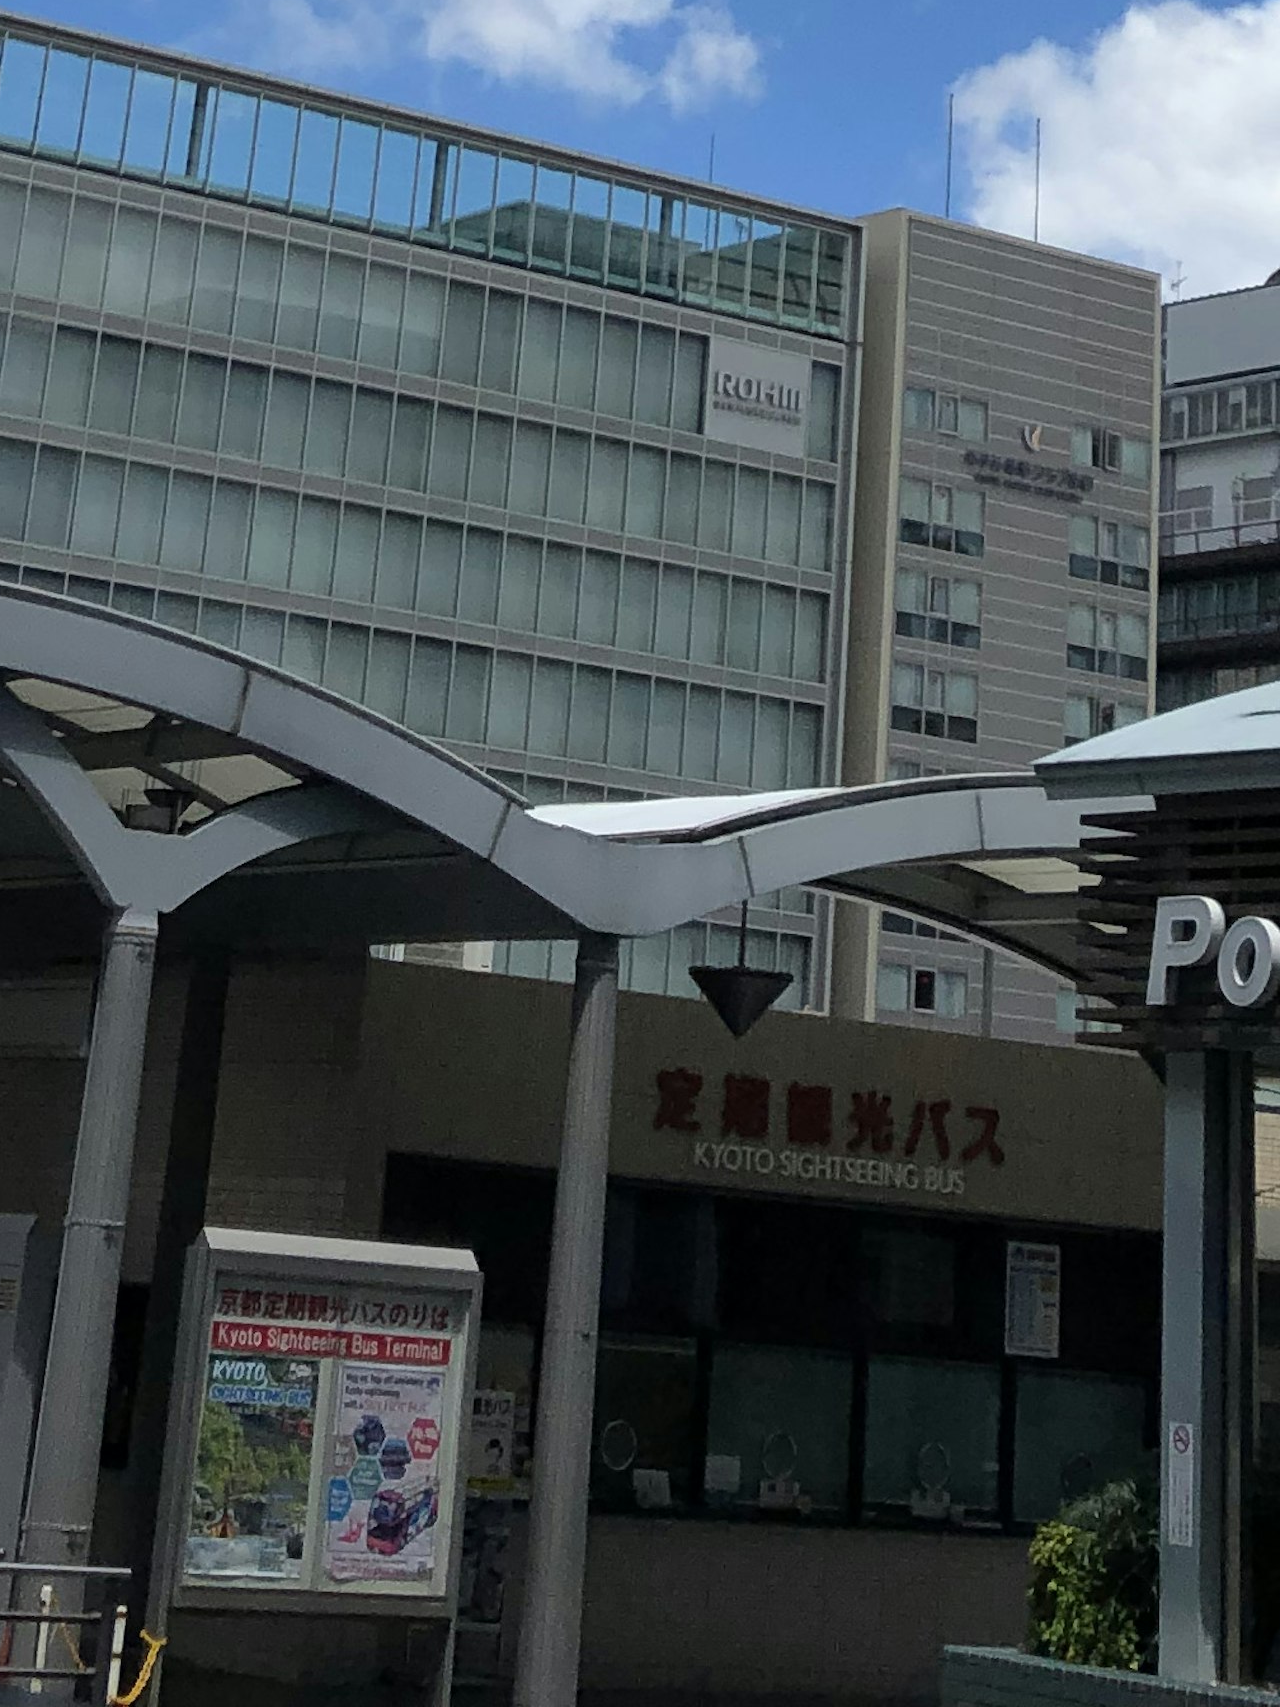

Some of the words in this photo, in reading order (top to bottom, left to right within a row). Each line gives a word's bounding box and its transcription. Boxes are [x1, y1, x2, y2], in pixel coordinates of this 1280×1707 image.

[713, 371, 801, 414] ROHM
[694, 1142, 774, 1175] KYOTO
[779, 1150, 919, 1191] SIGHTSEEING
[923, 1167, 966, 1195] BUS
[217, 1324, 262, 1348] Kyoto
[267, 1327, 347, 1355] Sightseeing
[352, 1333, 379, 1356] Bus
[385, 1337, 444, 1361] Terminal
[212, 1359, 266, 1383] KYOTO
